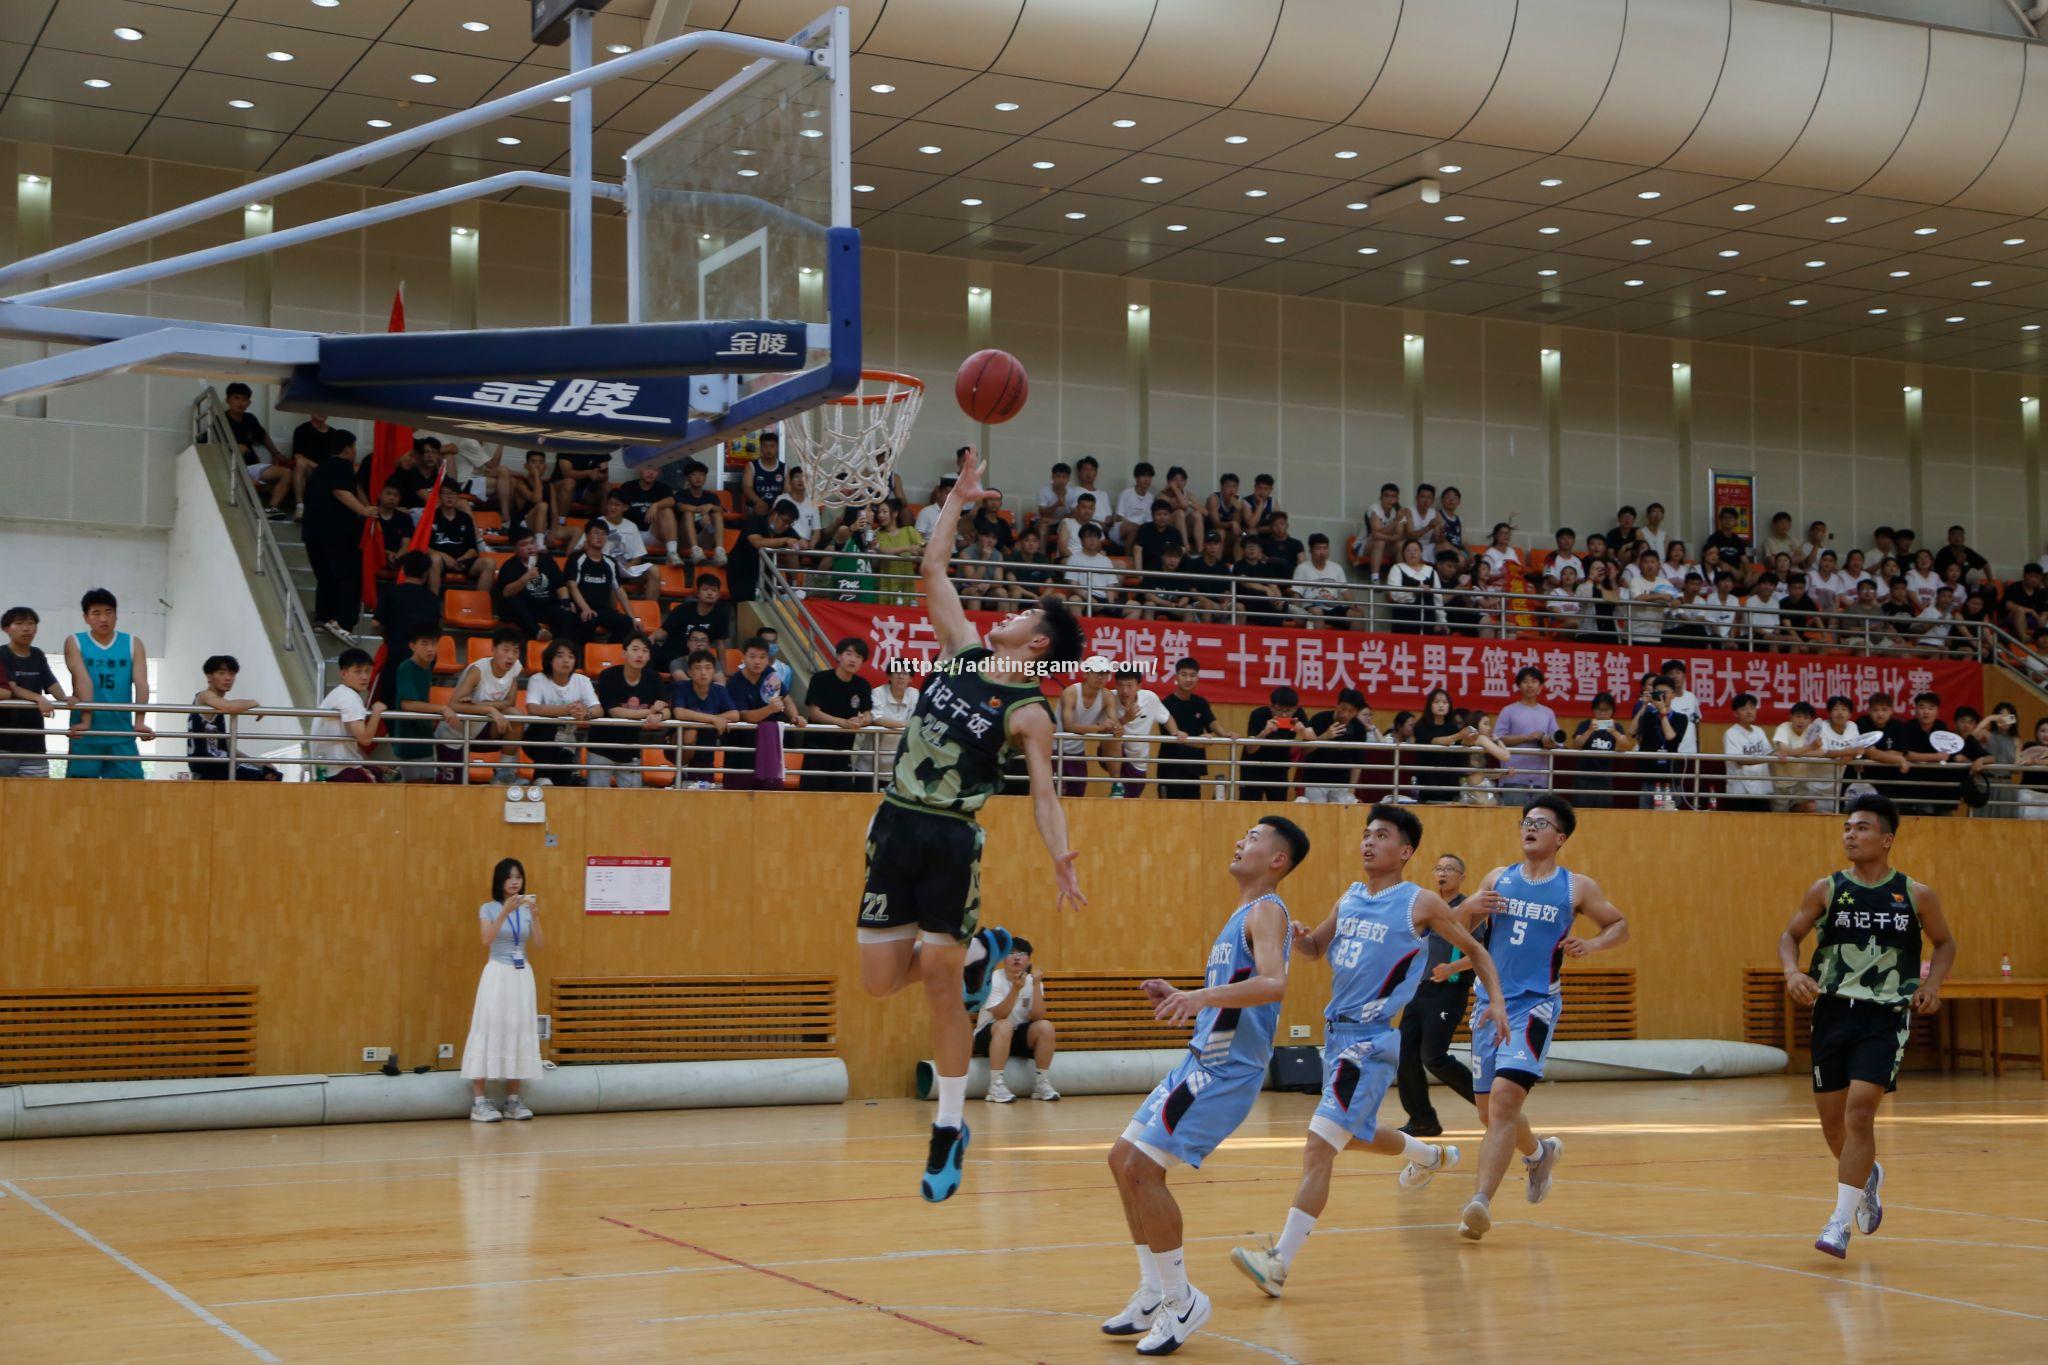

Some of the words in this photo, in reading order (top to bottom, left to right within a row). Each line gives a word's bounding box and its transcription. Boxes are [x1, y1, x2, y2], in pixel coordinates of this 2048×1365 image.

[717, 332, 797, 355] 金陵
[433, 379, 671, 424] 金陵
[869, 615, 1934, 716] 济宁学院第二十五届大学生男子篮球赛暨第届大学生啦啦操比赛
[99, 673, 115, 690] 15
[861, 892, 889, 921] 22
[1335, 917, 1389, 944] 就有效
[1510, 920, 1528, 945] 5
[1835, 911, 1909, 932] 高记干饭
[1206, 942, 1233, 968] 有效
[1335, 938, 1363, 969] 23
